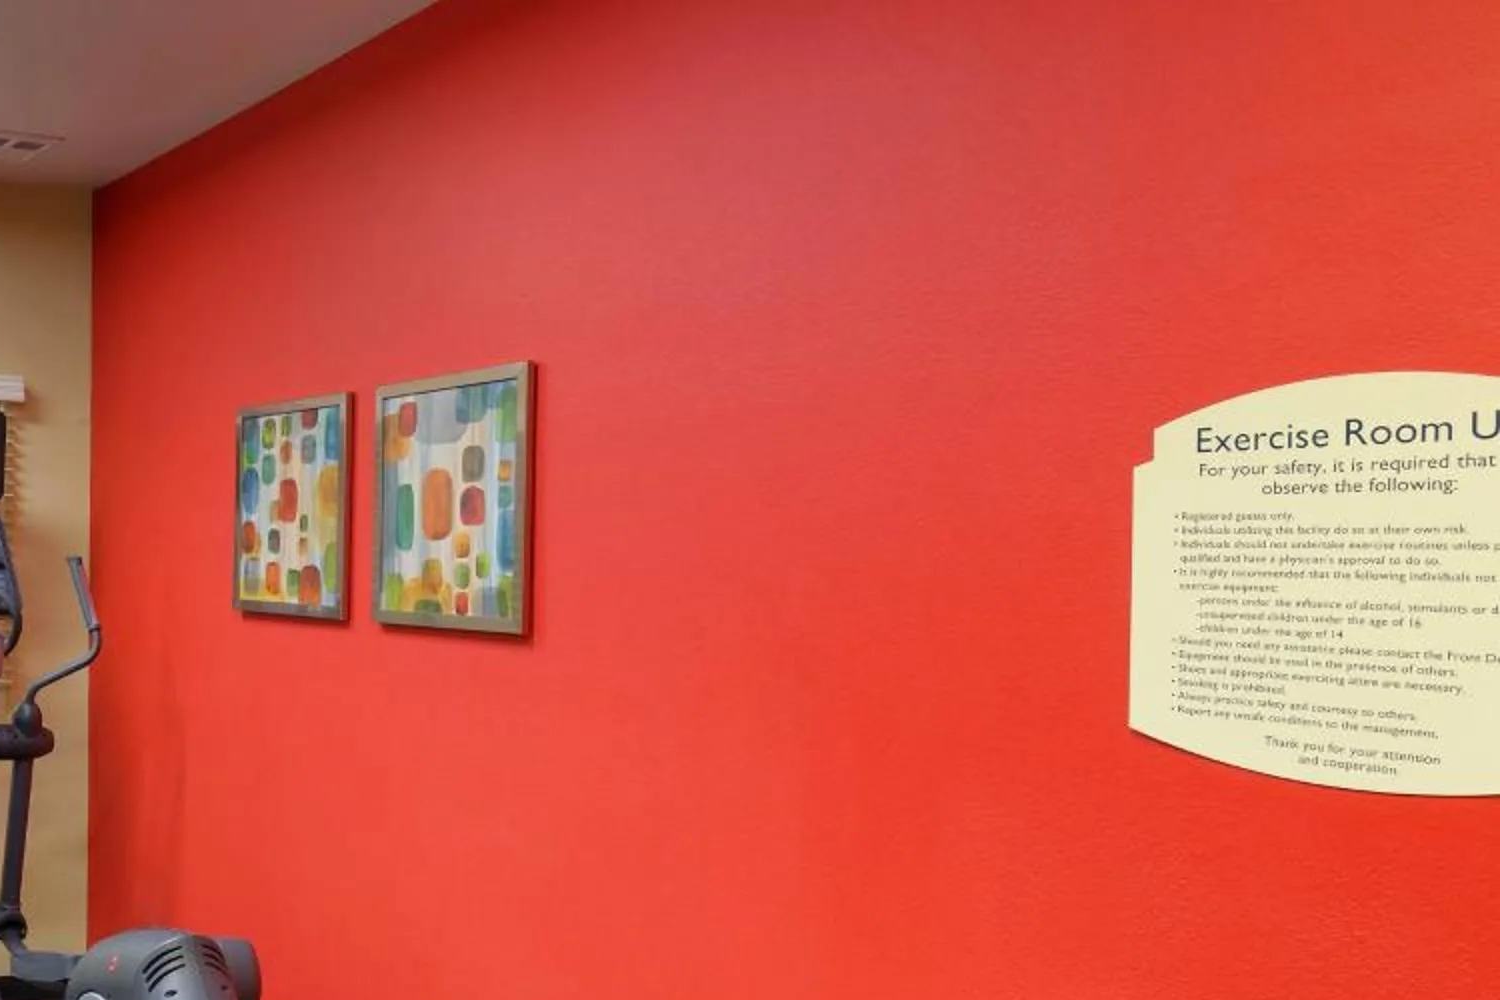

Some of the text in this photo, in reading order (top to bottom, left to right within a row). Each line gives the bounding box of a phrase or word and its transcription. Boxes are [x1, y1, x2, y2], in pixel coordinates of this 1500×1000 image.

[1196, 424, 1329, 453] Exercise
[1345, 419, 1453, 446] Room
[1199, 453, 1496, 479] For your safety, it is required that
[1262, 478, 1457, 495] observe the following:
[1334, 524, 1348, 534] do
[1368, 526, 1378, 534] at
[1384, 524, 1410, 534] their
[1224, 555, 1241, 563] and
[1338, 556, 1385, 567] approval
[1390, 557, 1400, 565] to
[1406, 557, 1420, 565] do
[1308, 570, 1329, 578] that
[1334, 571, 1351, 579] the
[1355, 571, 1406, 583] following
[1410, 572, 1470, 582] individuals
[1475, 574, 1497, 583] not
[1345, 601, 1357, 610] of
[1348, 617, 1365, 625] the
[1369, 618, 1388, 628] age
[1392, 618, 1404, 627] of
[1296, 631, 1312, 640] age
[1331, 630, 1343, 639] 14
[1377, 648, 1419, 659] contact
[1423, 650, 1443, 660] the
[1325, 658, 1343, 669] the
[1346, 662, 1397, 673] presence
[1401, 664, 1414, 674] of
[1342, 721, 1358, 731] the
[1328, 743, 1345, 754] for
[1349, 747, 1378, 757] your
[1382, 752, 1441, 765] attention
[1298, 756, 1319, 765] and
